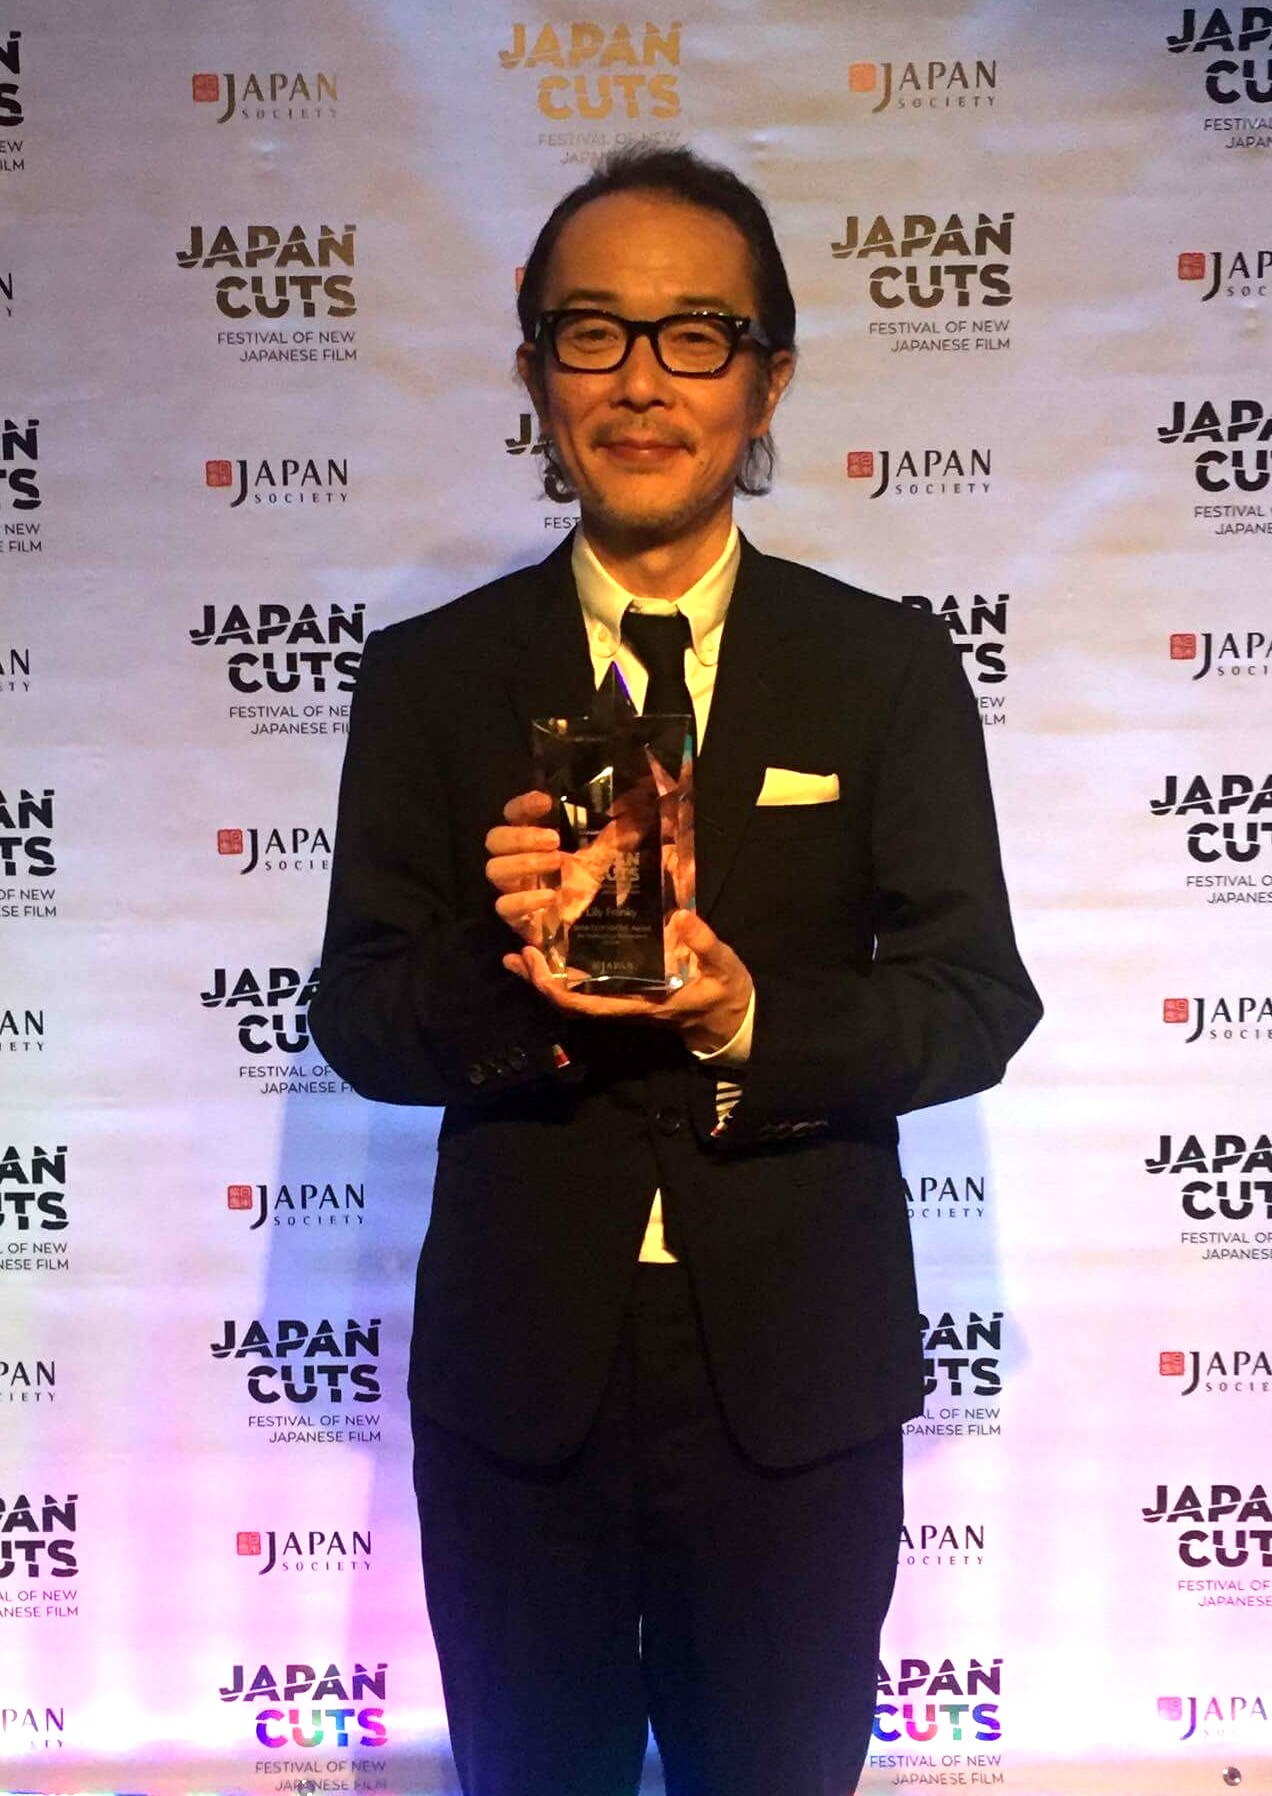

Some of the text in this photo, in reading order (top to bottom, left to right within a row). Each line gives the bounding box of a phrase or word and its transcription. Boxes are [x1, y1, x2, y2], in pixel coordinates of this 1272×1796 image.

[1166, 7, 1272, 53] JAP
[498, 21, 683, 70] JAPAN
[871, 60, 997, 113] JAPAN
[1205, 59, 1272, 104] CU
[217, 73, 338, 124] JAPAN
[537, 74, 681, 120] CUTS
[898, 96, 995, 109] SOCIETY
[241, 107, 337, 120] SOCIETY
[537, 132, 610, 147] FESTIVAL
[831, 212, 1015, 259] JAPAN
[175, 224, 358, 269] JAPAN
[1200, 251, 1272, 302] JAP
[869, 264, 1013, 309] CUTS
[216, 275, 358, 319] CUTS
[869, 320, 1011, 335] FESTIVAL OF NEW
[217, 330, 355, 345] FESTIVAL OF NEW
[891, 338, 1010, 352] JAPANESE FILM
[239, 348, 357, 362] JAPANESE FILM
[1157, 400, 1272, 444] JAP
[870, 449, 991, 499] JAPAN
[1195, 450, 1272, 492] CU
[230, 458, 349, 508] JAPAN
[895, 483, 992, 495] SOCIETY
[254, 492, 349, 504] SOCIETY
[1194, 505, 1265, 518] FESTIVAL
[5, 523, 41, 536] NEW
[544, 516, 581, 529] FEST
[1215, 523, 1272, 535] JAPANE
[9, 541, 42, 553] FILM
[189, 603, 366, 646] JAPAN
[1192, 632, 1272, 681] JAP
[227, 652, 362, 693] CUTS
[1217, 665, 1269, 676] SOCI
[975, 697, 1005, 708] EW
[229, 705, 350, 718] FESTIVAL OF NE
[250, 722, 328, 735] JAPANESE
[1150, 774, 1272, 816] JAPA
[0, 836, 57, 877] TS
[239, 827, 333, 876] JAPA
[264, 859, 330, 871] SOCIE
[1186, 875, 1257, 888] FESTIVAL
[20, 889, 56, 900] NEW
[1207, 892, 1272, 904] JAPANES
[24, 905, 57, 917] FILM
[200, 967, 321, 1008] JAPA
[1185, 997, 1272, 1044] JAPA
[237, 1013, 310, 1054] CU
[239, 1065, 307, 1078] FESTIVAL
[260, 1081, 337, 1094] JAPANESE
[1145, 1134, 1272, 1174] JAPA
[249, 1183, 366, 1231] JAPAN
[1181, 1180, 1272, 1220] CUT
[0, 1191, 70, 1230] TS
[906, 1208, 985, 1218] OCIETY
[273, 1214, 366, 1226] SOCIETY
[1181, 1232, 1250, 1244] FESTIVAL
[8, 1242, 68, 1254] OF NEW
[37, 1258, 69, 1271] FILM
[209, 1318, 382, 1359] JAPAN
[0, 1360, 56, 1387] PAN
[1181, 1351, 1272, 1396] JAPA
[247, 1363, 382, 1403] CUTS
[1205, 1381, 1270, 1392] SOCIE
[248, 1414, 381, 1427] FESTIVAL OF NEW
[940, 1408, 961, 1420] OF
[965, 1408, 1000, 1420] NEW
[269, 1431, 381, 1443] JAPANESE FILM
[968, 1424, 1001, 1436] FILM
[1141, 1485, 1272, 1523] JAPA
[899, 1525, 984, 1550] APAN
[258, 1531, 371, 1576] JAPAN
[1178, 1530, 1272, 1568] CUT
[0, 1538, 79, 1578] UTS
[899, 1556, 984, 1565] OCIETY
[282, 1560, 371, 1572] SOCIETY
[1178, 1579, 1271, 1592] FESTIVAL OF
[18, 1590, 38, 1602] OF
[43, 1589, 78, 1601] NEW
[46, 1606, 79, 1618] FILM
[219, 1663, 388, 1702] JAPAN
[876, 1658, 1004, 1696] APAN
[1, 1707, 64, 1732] PAN
[871, 1703, 1003, 1742] CUTS
[1179, 1696, 1269, 1741] JAPA
[255, 1708, 388, 1748] CUTS
[255, 1760, 387, 1774] FESTIVAL OF NEW
[870, 1754, 1002, 1768] FESTIVAL OF NEW
[353, 1779, 387, 1790] FILM
[892, 1773, 1004, 1785] JAPANESE FILM
